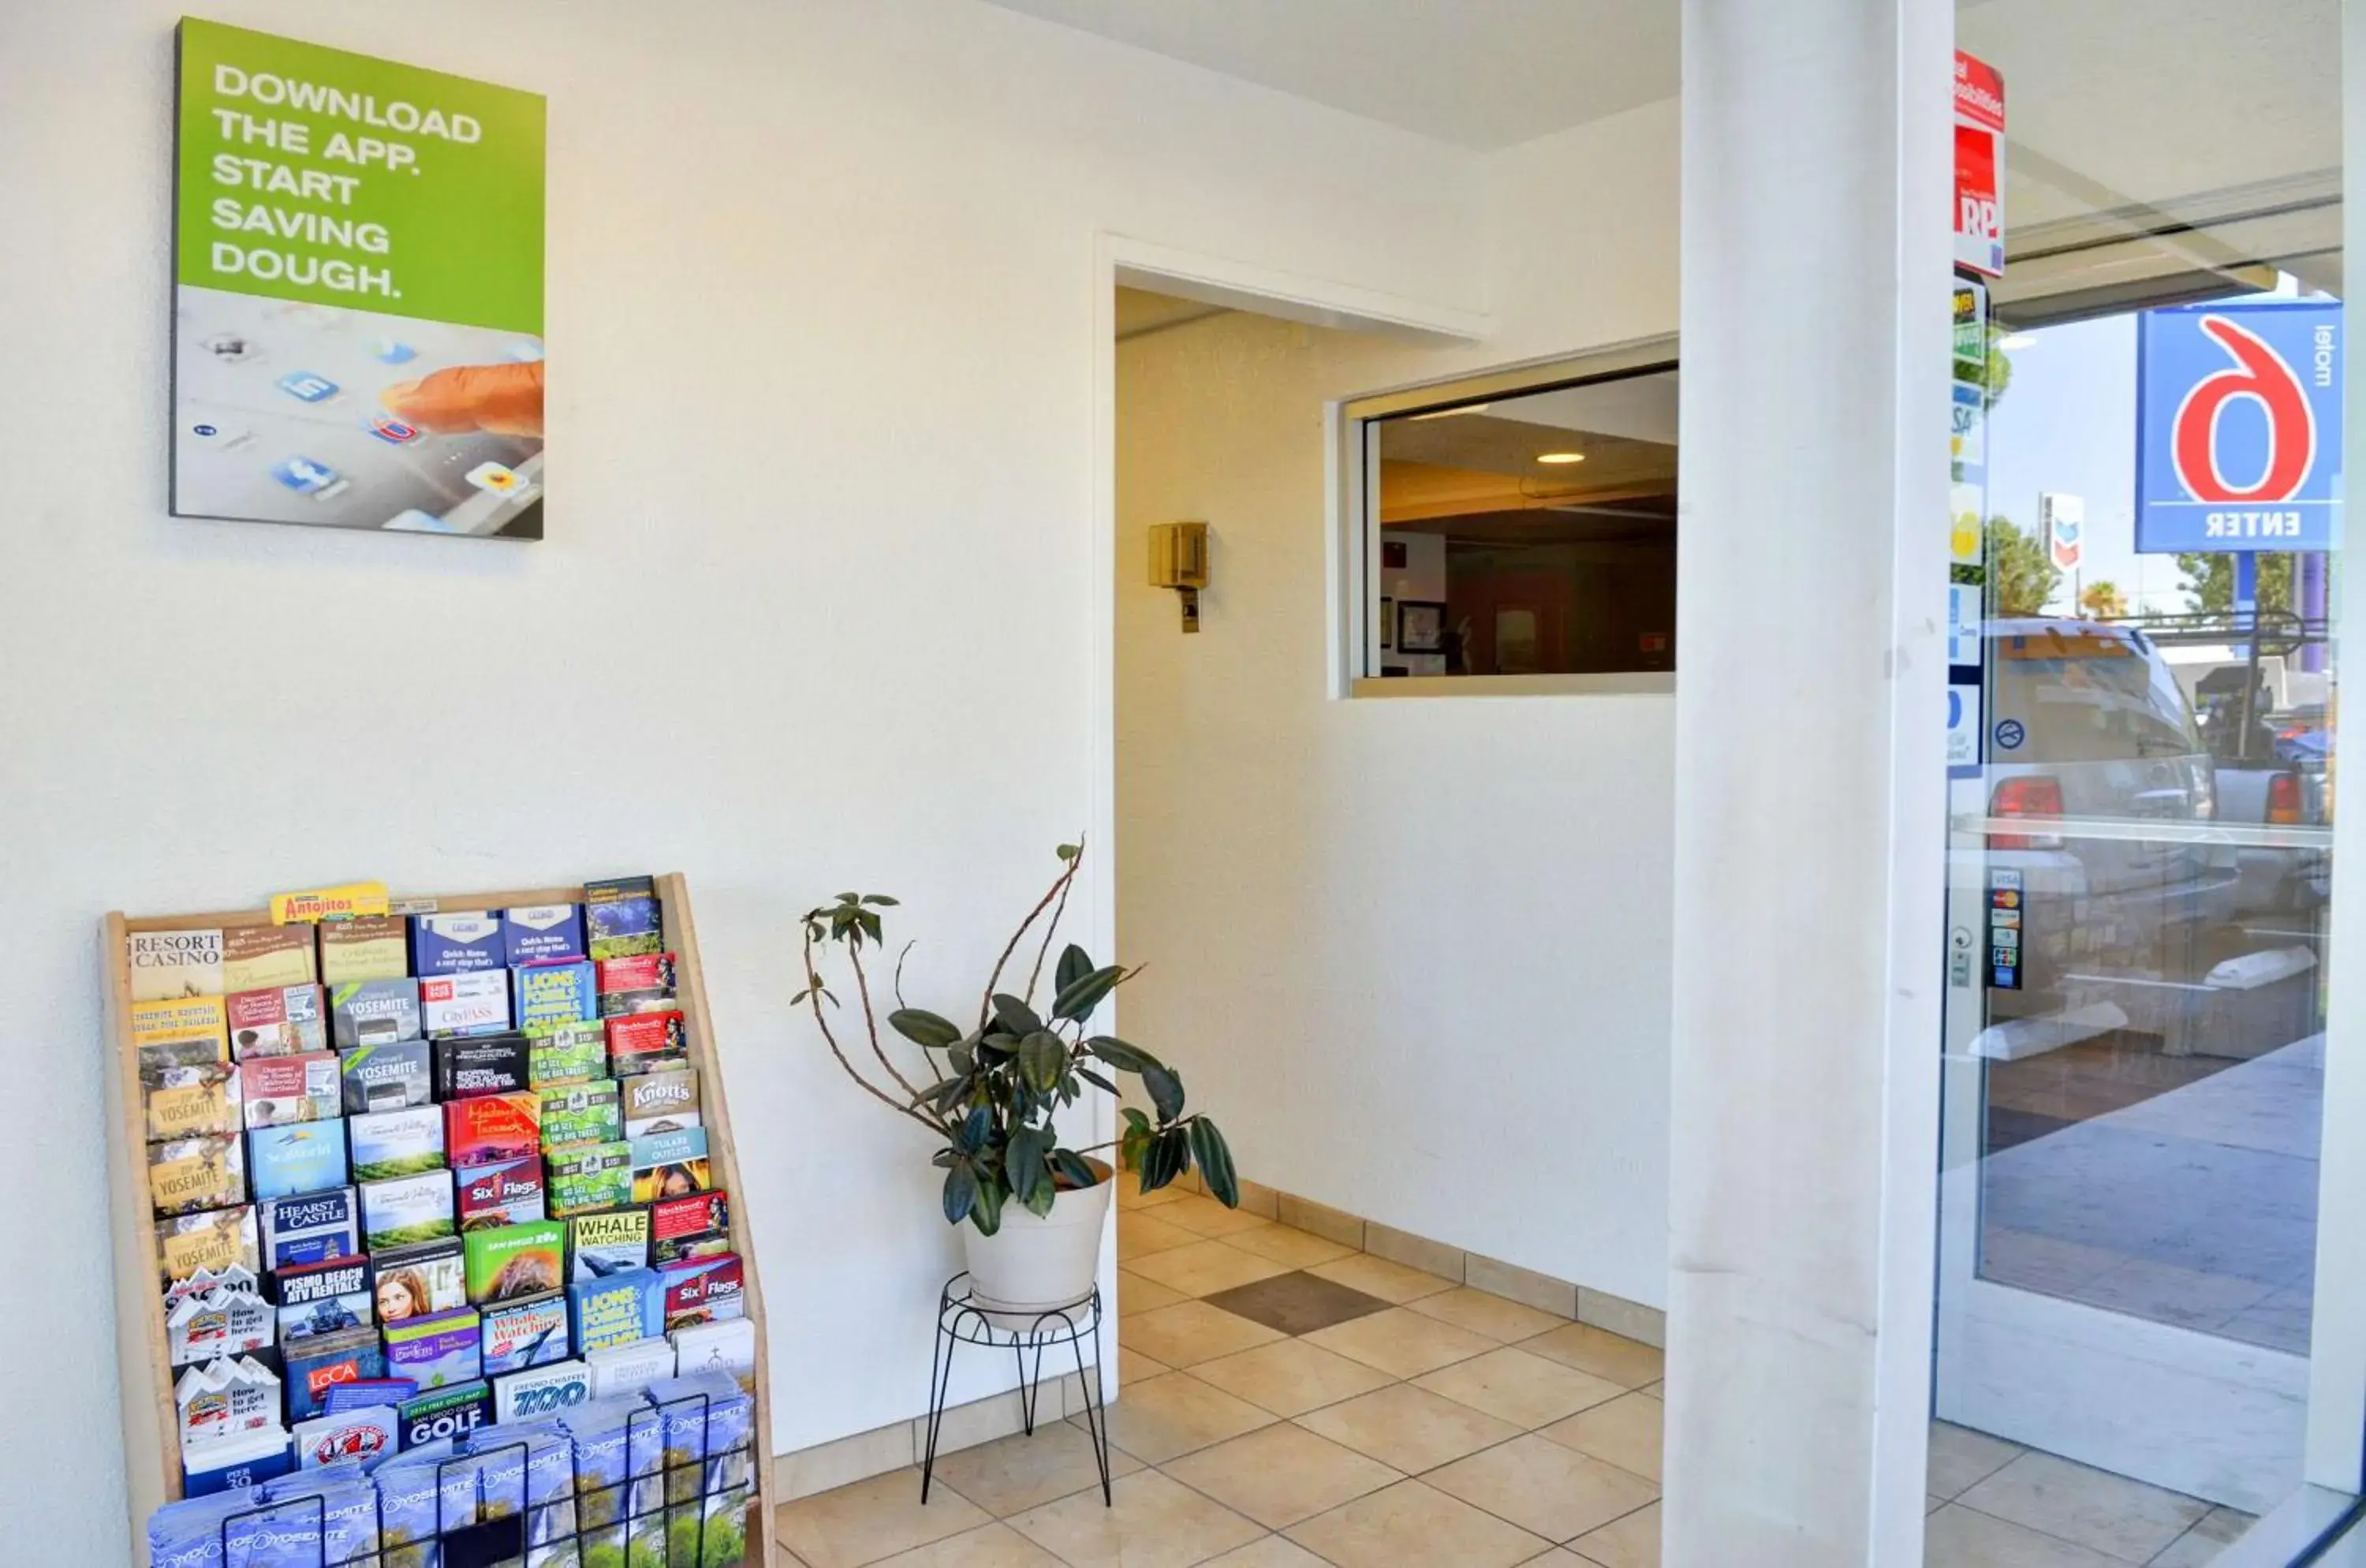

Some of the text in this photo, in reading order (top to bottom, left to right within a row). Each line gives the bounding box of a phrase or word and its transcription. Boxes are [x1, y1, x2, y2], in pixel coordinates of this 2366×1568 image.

[215, 64, 482, 144] DOWNLOAD
[212, 109, 420, 175] THE APP.
[211, 154, 360, 204] START
[211, 198, 389, 253] SAVING
[1959, 196, 1997, 238] RP
[211, 242, 401, 298] DOUGH.
[285, 896, 353, 918] Antojitos
[136, 935, 219, 952] RESORT
[136, 950, 218, 968] CASINO
[347, 998, 410, 1015] YOSEMITE
[357, 1061, 418, 1080] YOSEMITE
[634, 1081, 690, 1107] Knott's
[159, 1099, 218, 1123] YOSEMITE
[159, 1169, 220, 1196] YOSEMITE
[472, 1187, 494, 1200] Six
[503, 1180, 539, 1195] Flags
[279, 1200, 337, 1220] HEARST
[289, 1208, 345, 1228] CASTLE
[579, 1216, 646, 1236] WHALE
[581, 1232, 642, 1246] WATCHING
[174, 1241, 235, 1269] YOSEMITE
[284, 1267, 364, 1293] PISMO BEACH
[286, 1278, 362, 1304] ATV RENTALS
[680, 1279, 739, 1301] Six Flags
[231, 1309, 255, 1318] How
[245, 1315, 263, 1327] get
[494, 1312, 539, 1328] Whale
[494, 1316, 563, 1340] Watching
[233, 1388, 256, 1398] How
[247, 1392, 264, 1404] get
[410, 1409, 482, 1445] GOLF
